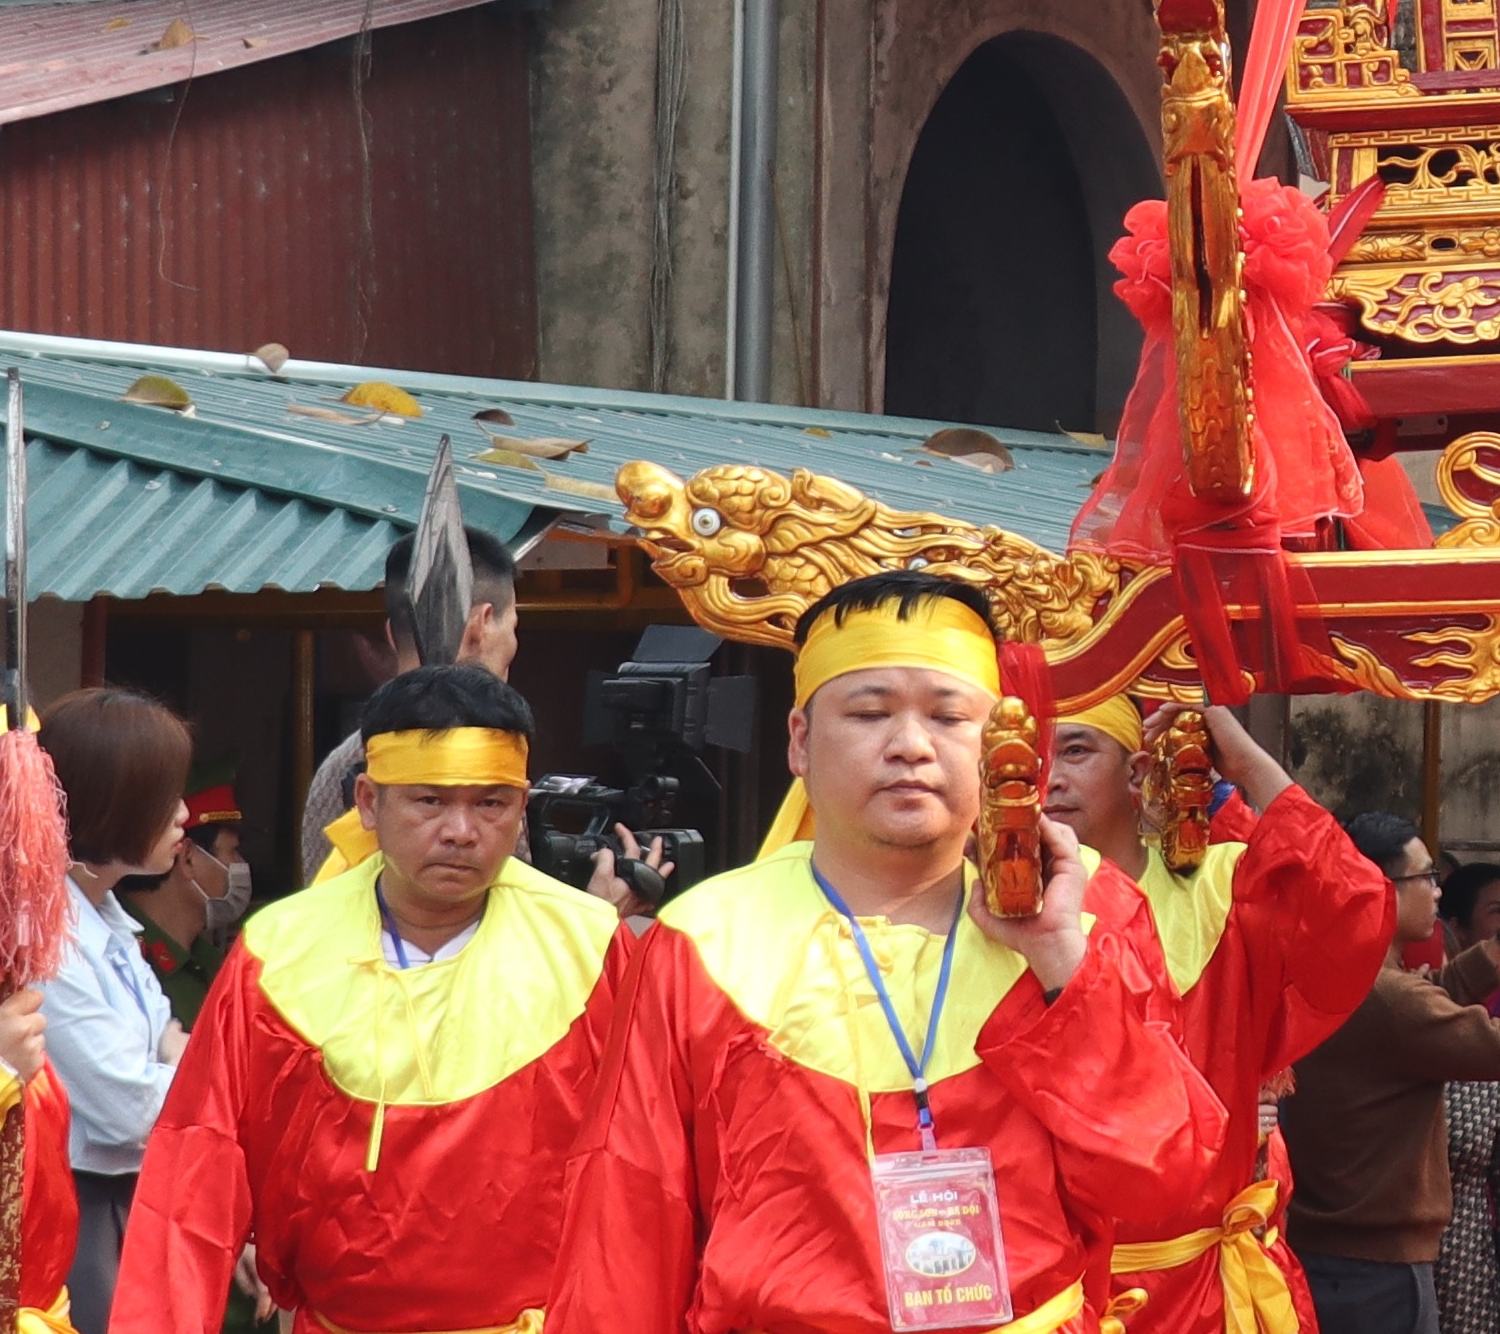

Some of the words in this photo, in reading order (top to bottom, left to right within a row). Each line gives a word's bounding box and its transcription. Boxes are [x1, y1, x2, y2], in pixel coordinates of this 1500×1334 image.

[904, 1288, 934, 1308] BAN
[935, 1283, 953, 1304] TỔ
[956, 1283, 993, 1302] CHỨC
